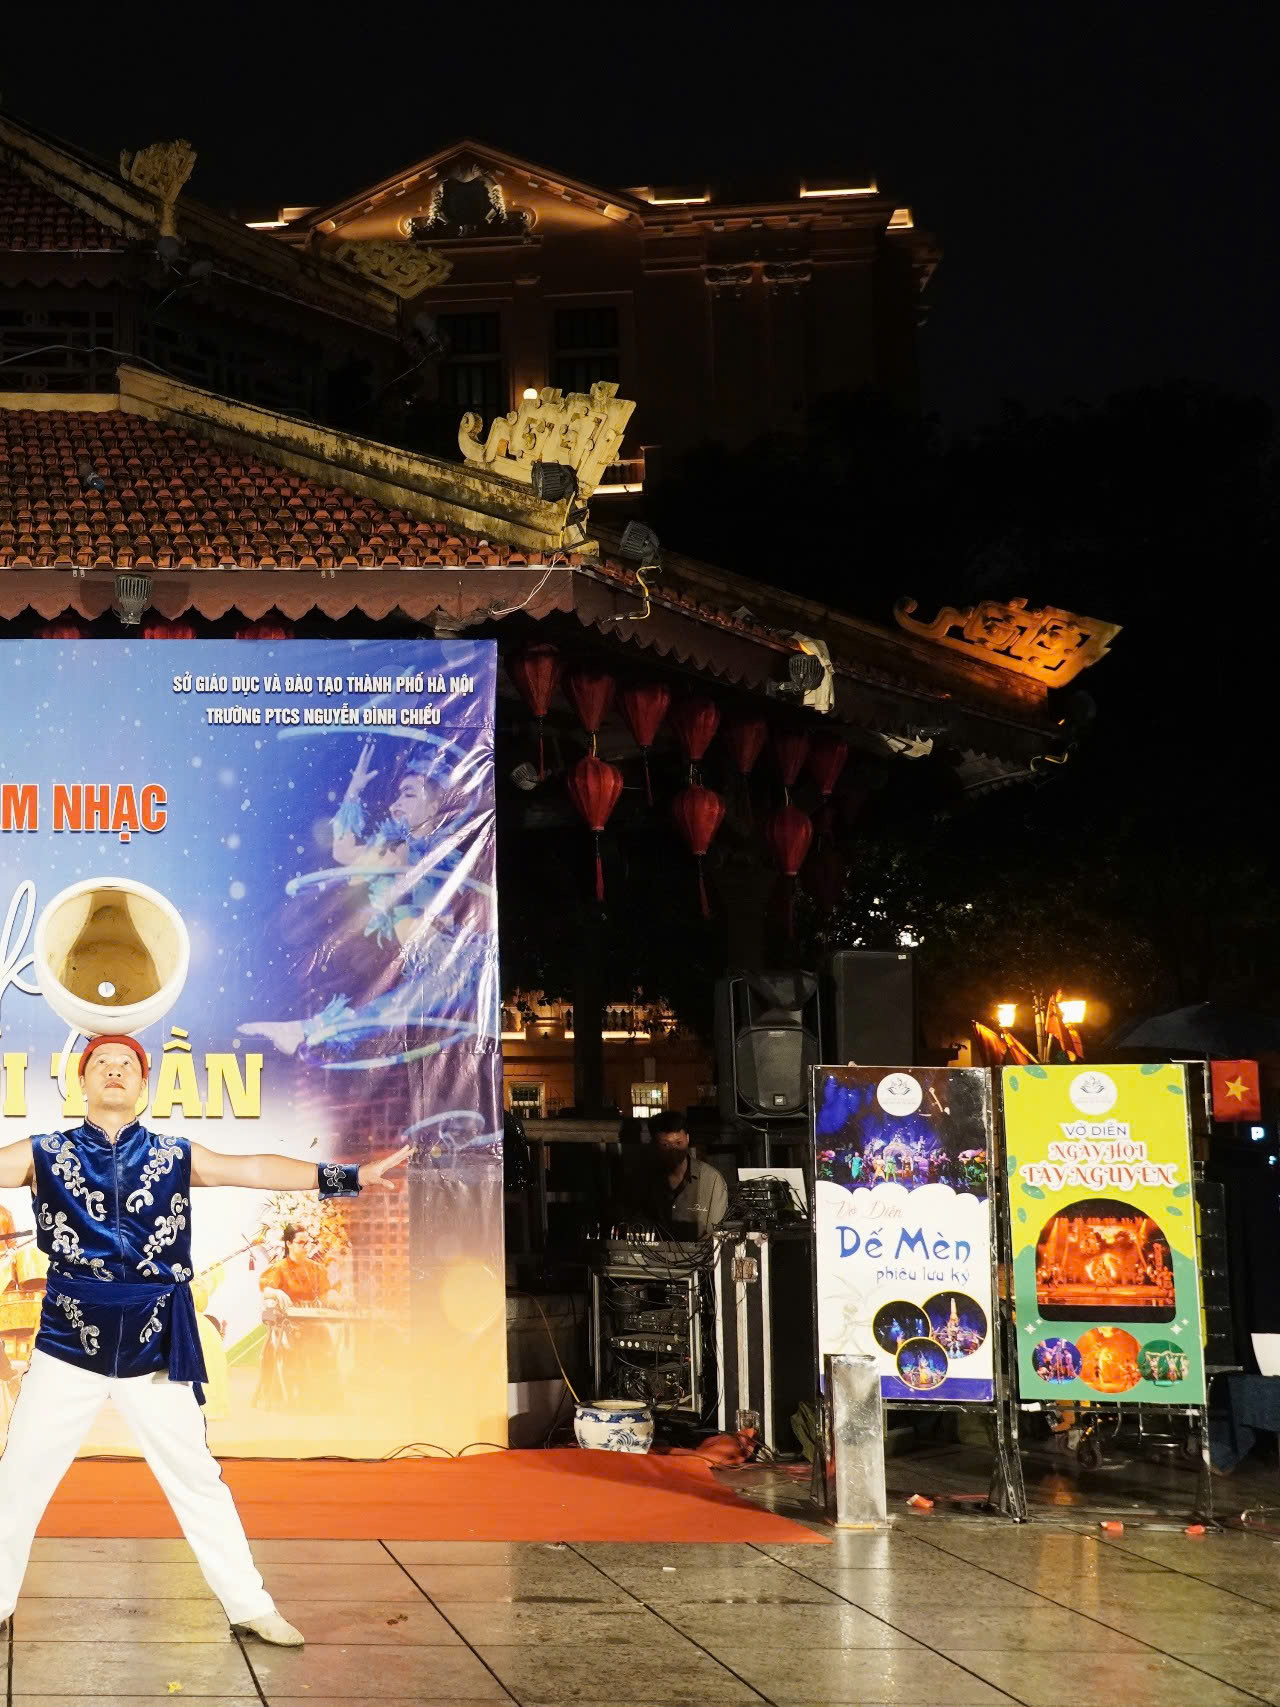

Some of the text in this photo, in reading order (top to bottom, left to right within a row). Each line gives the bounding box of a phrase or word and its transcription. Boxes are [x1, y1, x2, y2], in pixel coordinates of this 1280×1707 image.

[173, 671, 474, 697] SỞ GIÁO DỤC VÀ ĐÀO TẠO THÀNH PHỐ HÀ NỘI
[206, 702, 441, 725] TRƯỜNG PTCS NGUYỄN ĐÌNH CHIỂU
[52, 782, 168, 843] NHẠC
[50, 1025, 263, 1118] TẦN
[835, 1226, 971, 1263] Dế Mèn
